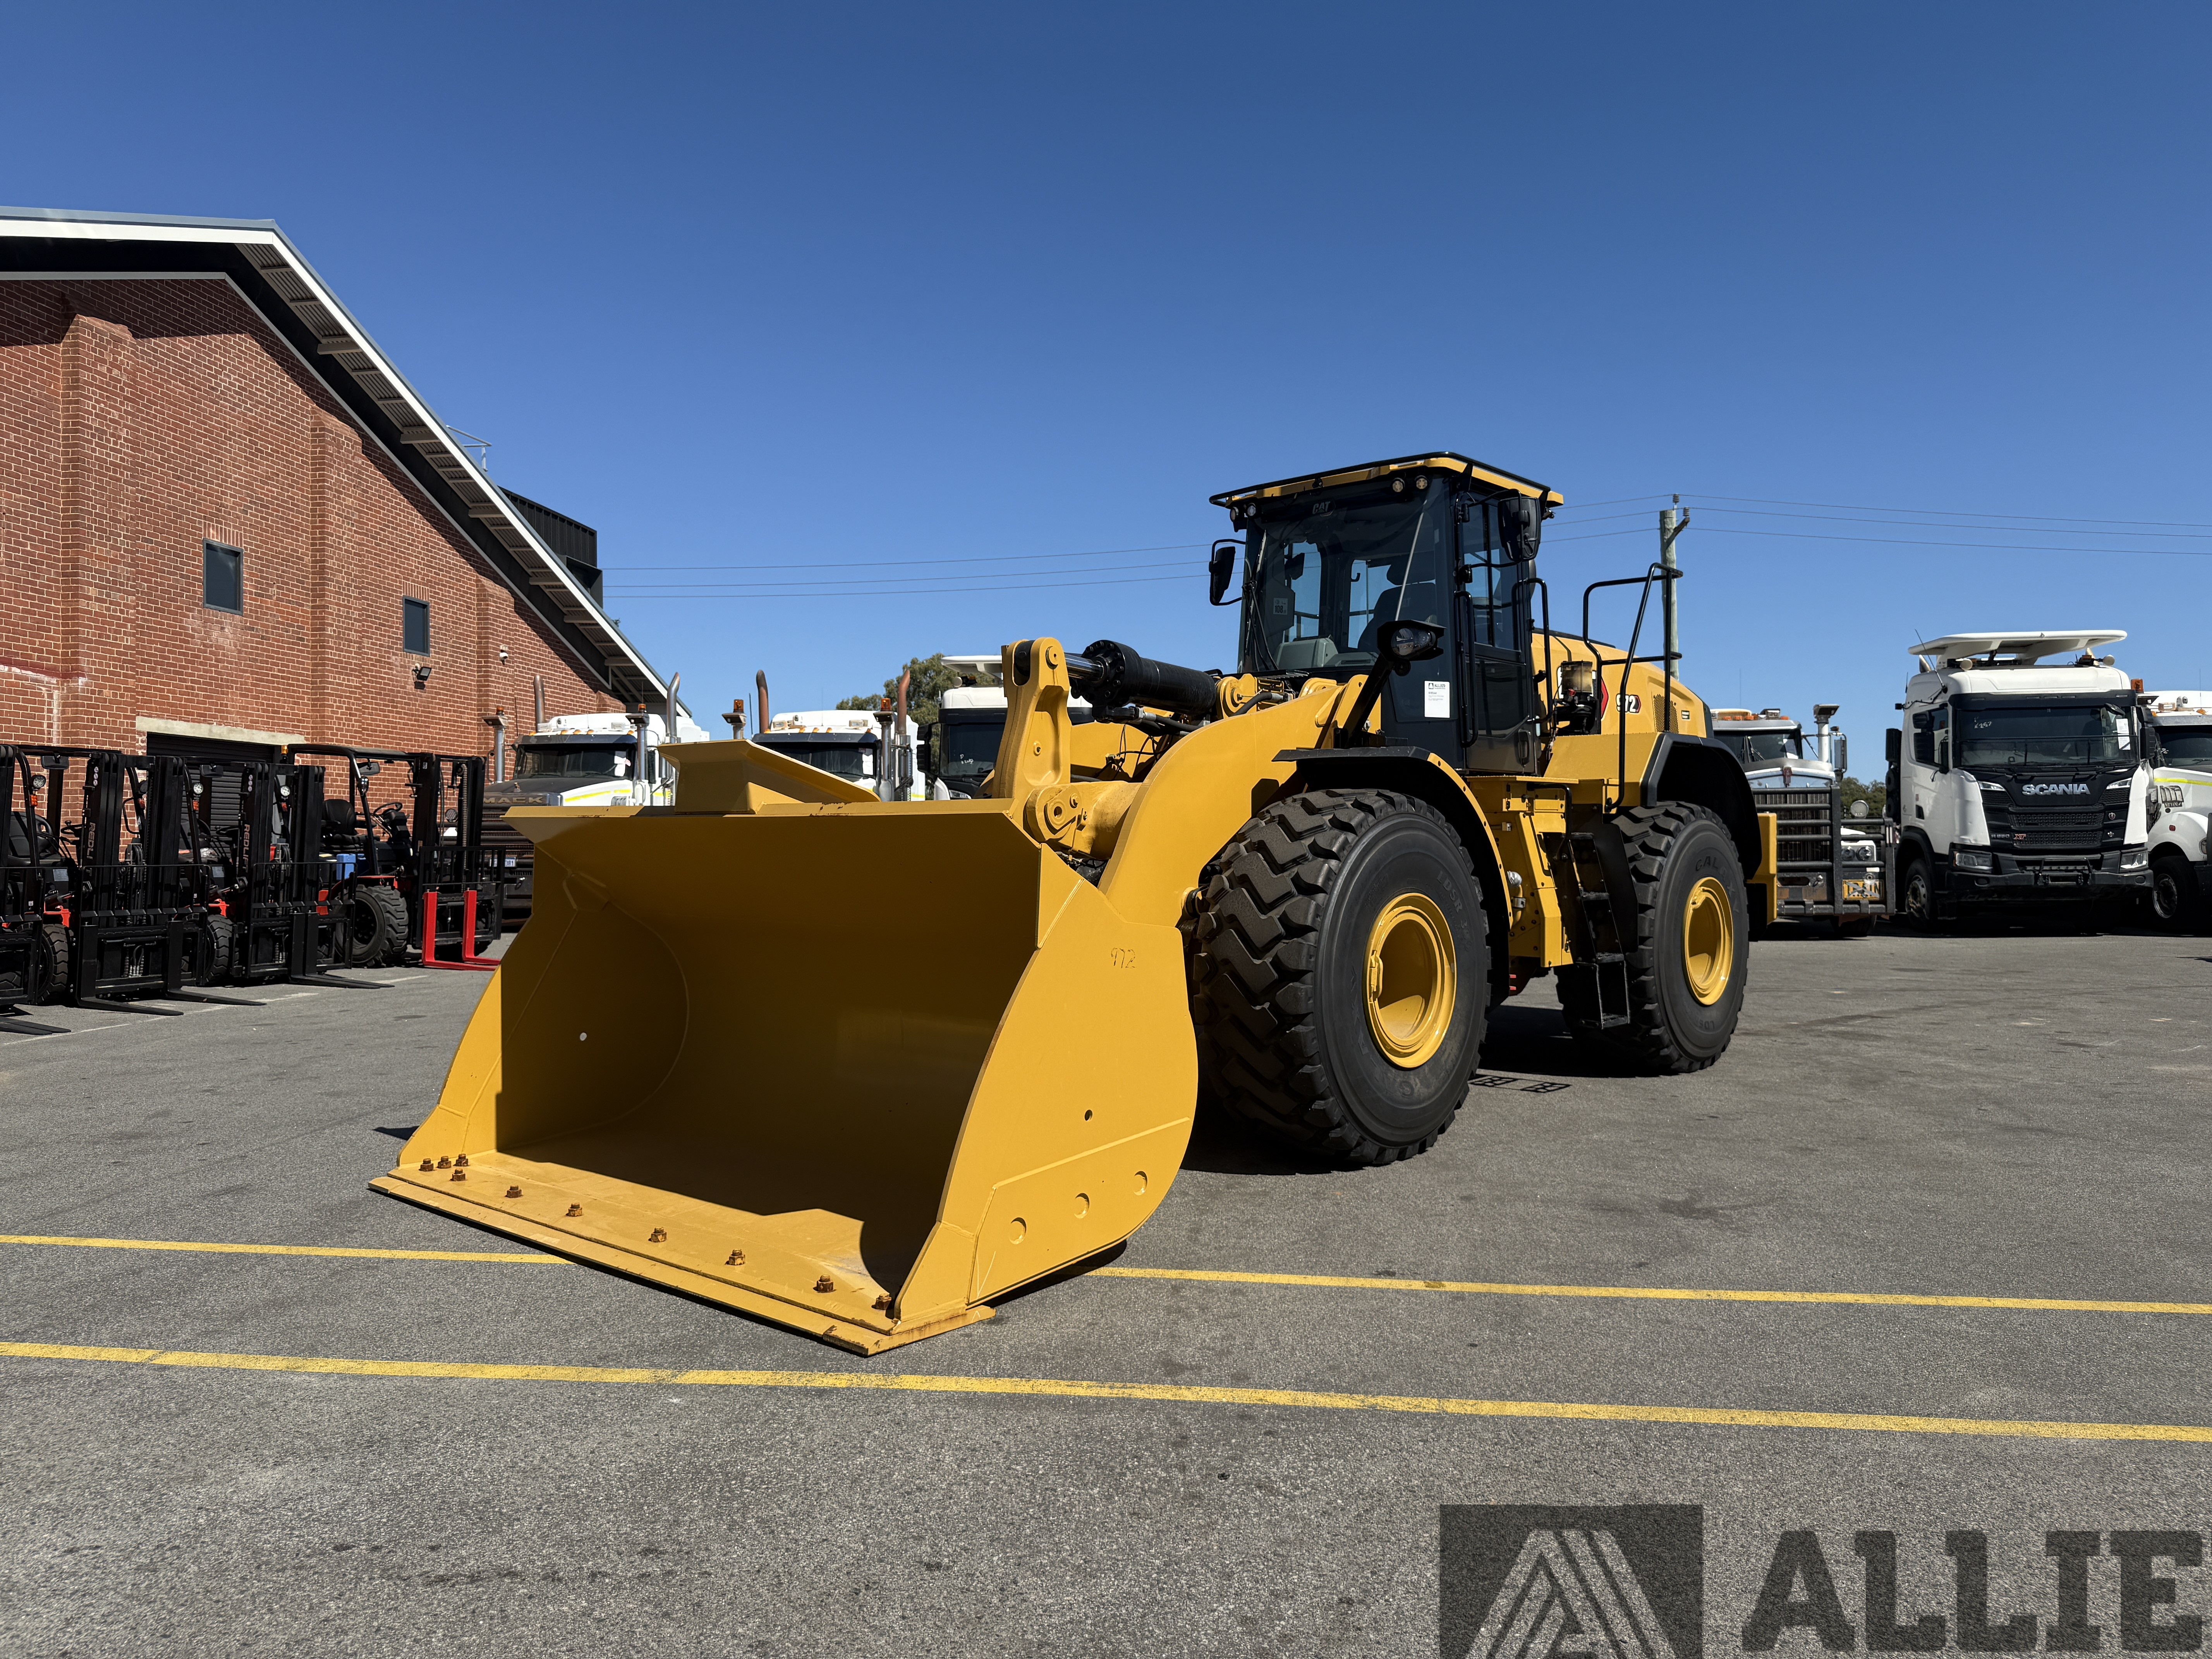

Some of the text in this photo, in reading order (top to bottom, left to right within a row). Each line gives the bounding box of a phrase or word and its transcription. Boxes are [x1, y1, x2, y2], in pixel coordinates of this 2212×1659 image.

[1312, 501, 1331, 515] CAT
[1275, 605, 1283, 613] 108
[2022, 784, 2090, 795] SCANIA
[86, 822, 96, 877] REDLIT
[1436, 870, 1463, 914] LDSR
[1111, 947, 1136, 969] 972
